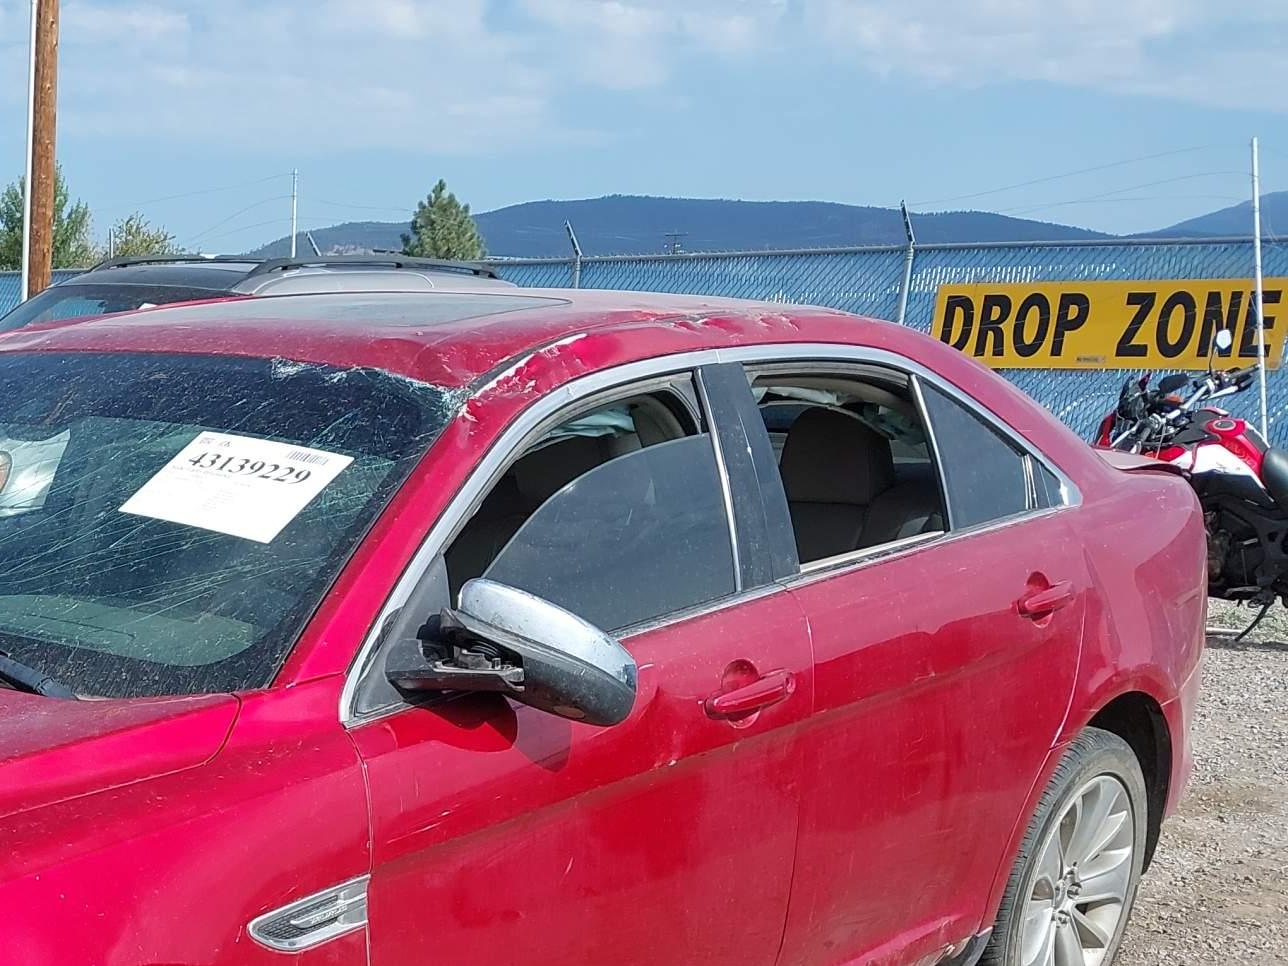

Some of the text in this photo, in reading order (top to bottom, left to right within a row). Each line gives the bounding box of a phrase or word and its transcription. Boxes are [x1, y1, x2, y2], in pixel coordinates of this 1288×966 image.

[940, 289, 1283, 358] DROP ZONE
[189, 452, 311, 485] 43139229
